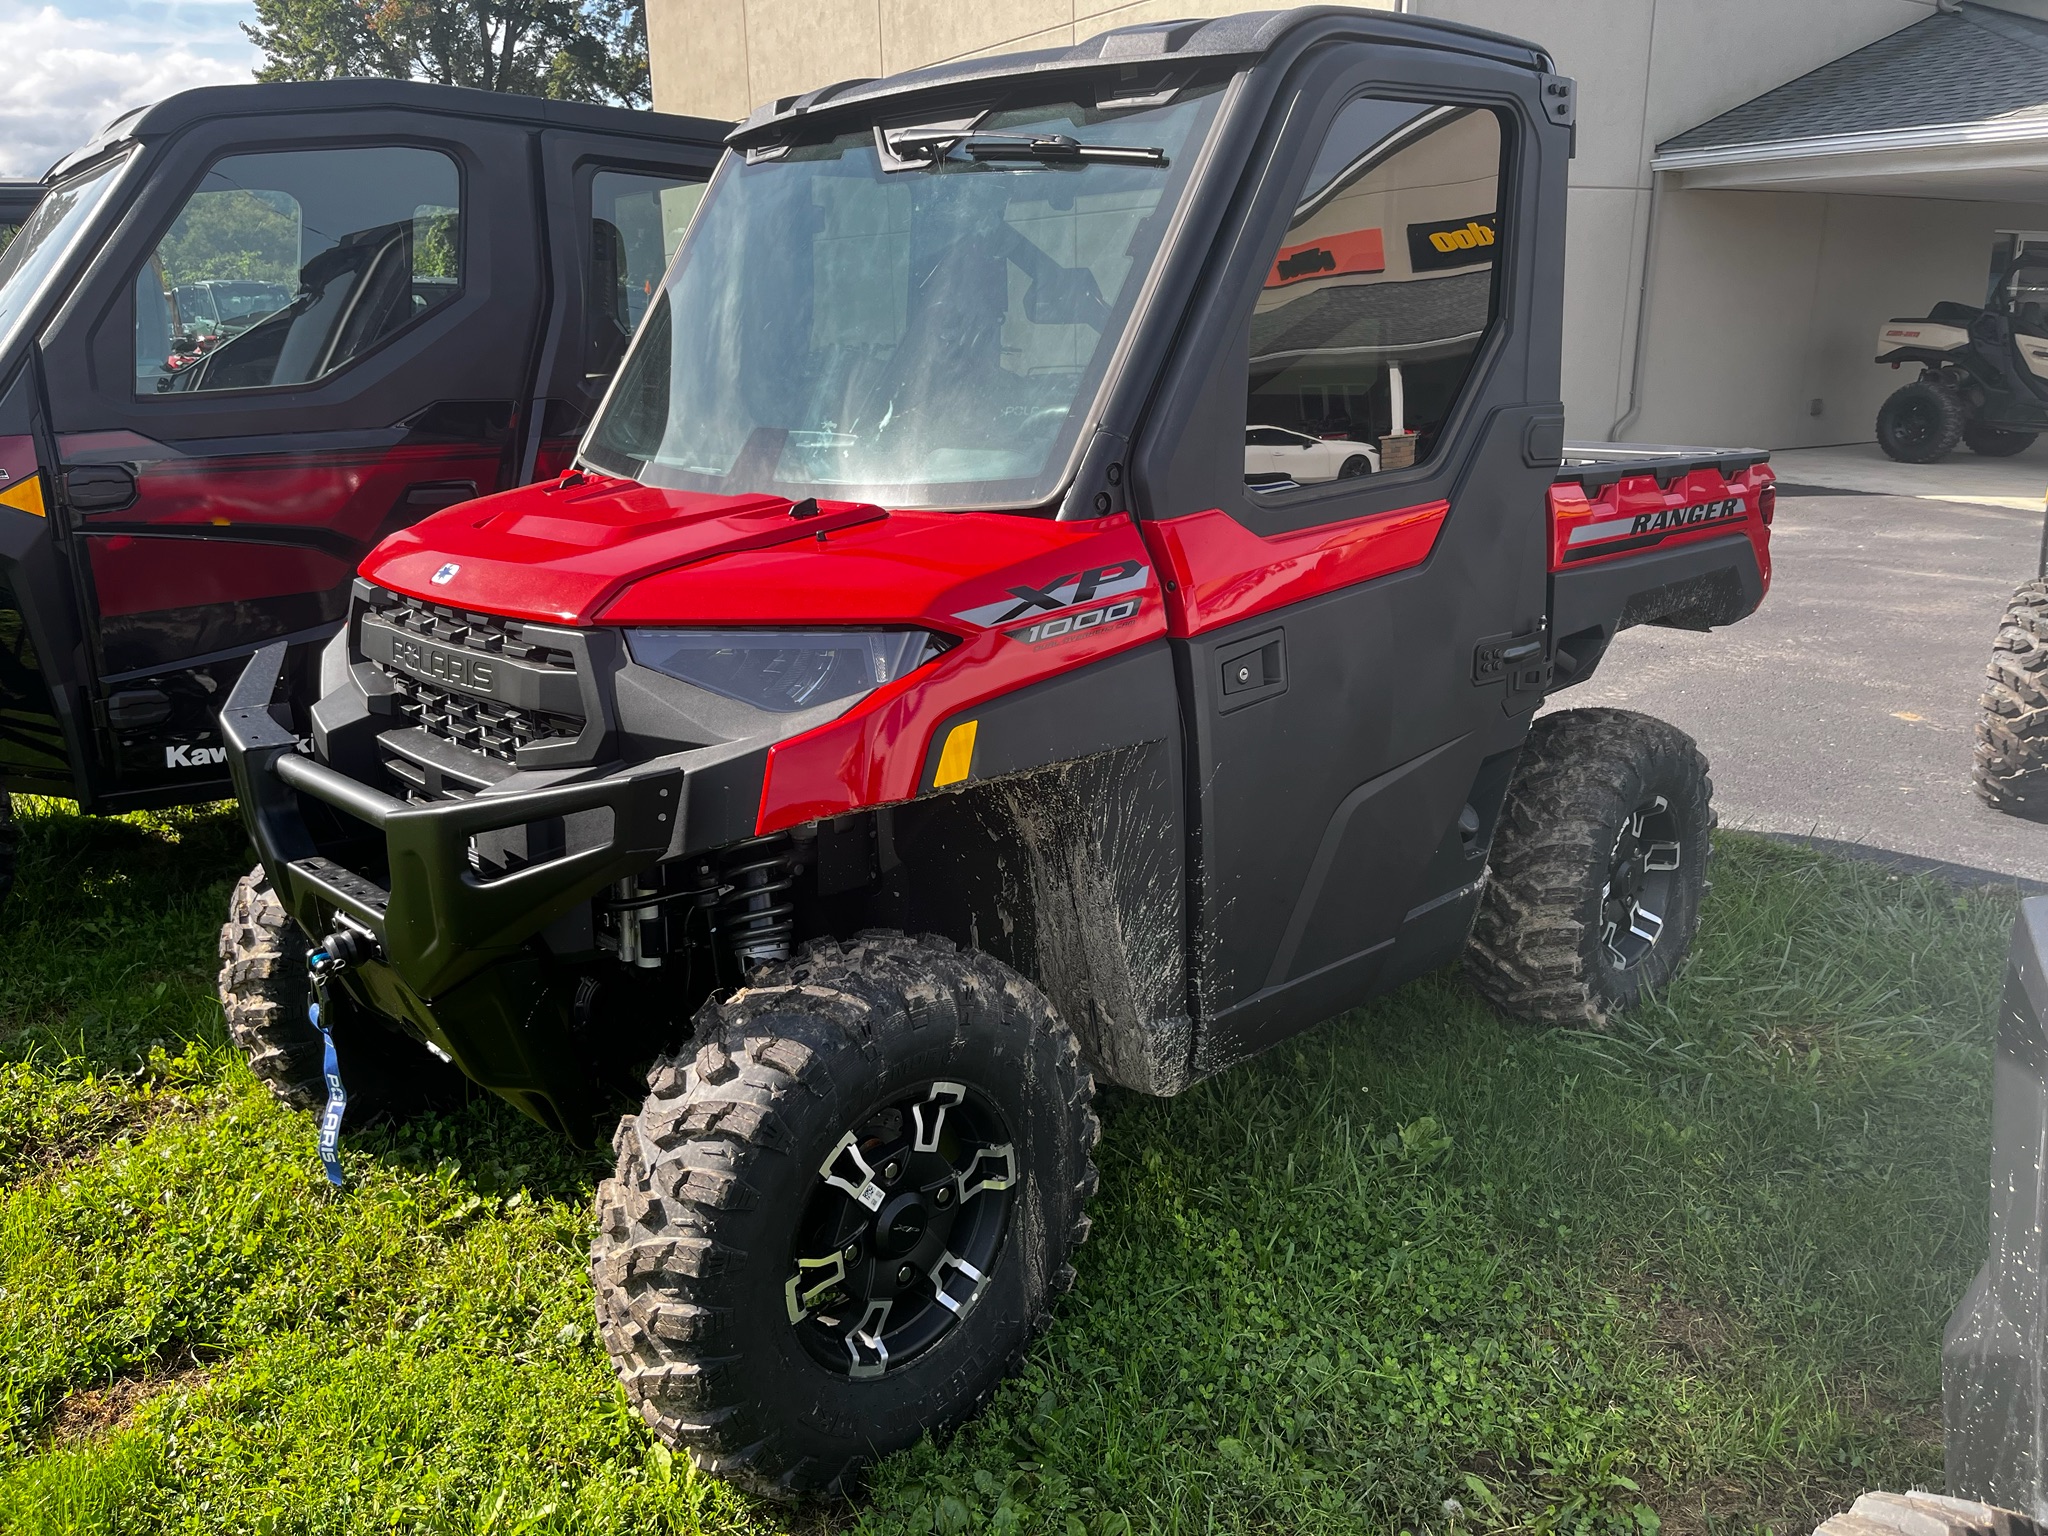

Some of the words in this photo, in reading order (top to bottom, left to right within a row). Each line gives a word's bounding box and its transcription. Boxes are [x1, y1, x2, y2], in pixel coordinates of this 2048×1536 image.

[1630, 498, 1737, 535] RANGER
[991, 559, 1143, 625] XP
[1029, 601, 1134, 642] 1000
[392, 635, 494, 692] POLARIS
[166, 733, 315, 768] Kawki
[321, 1073, 343, 1163] POLARIS
